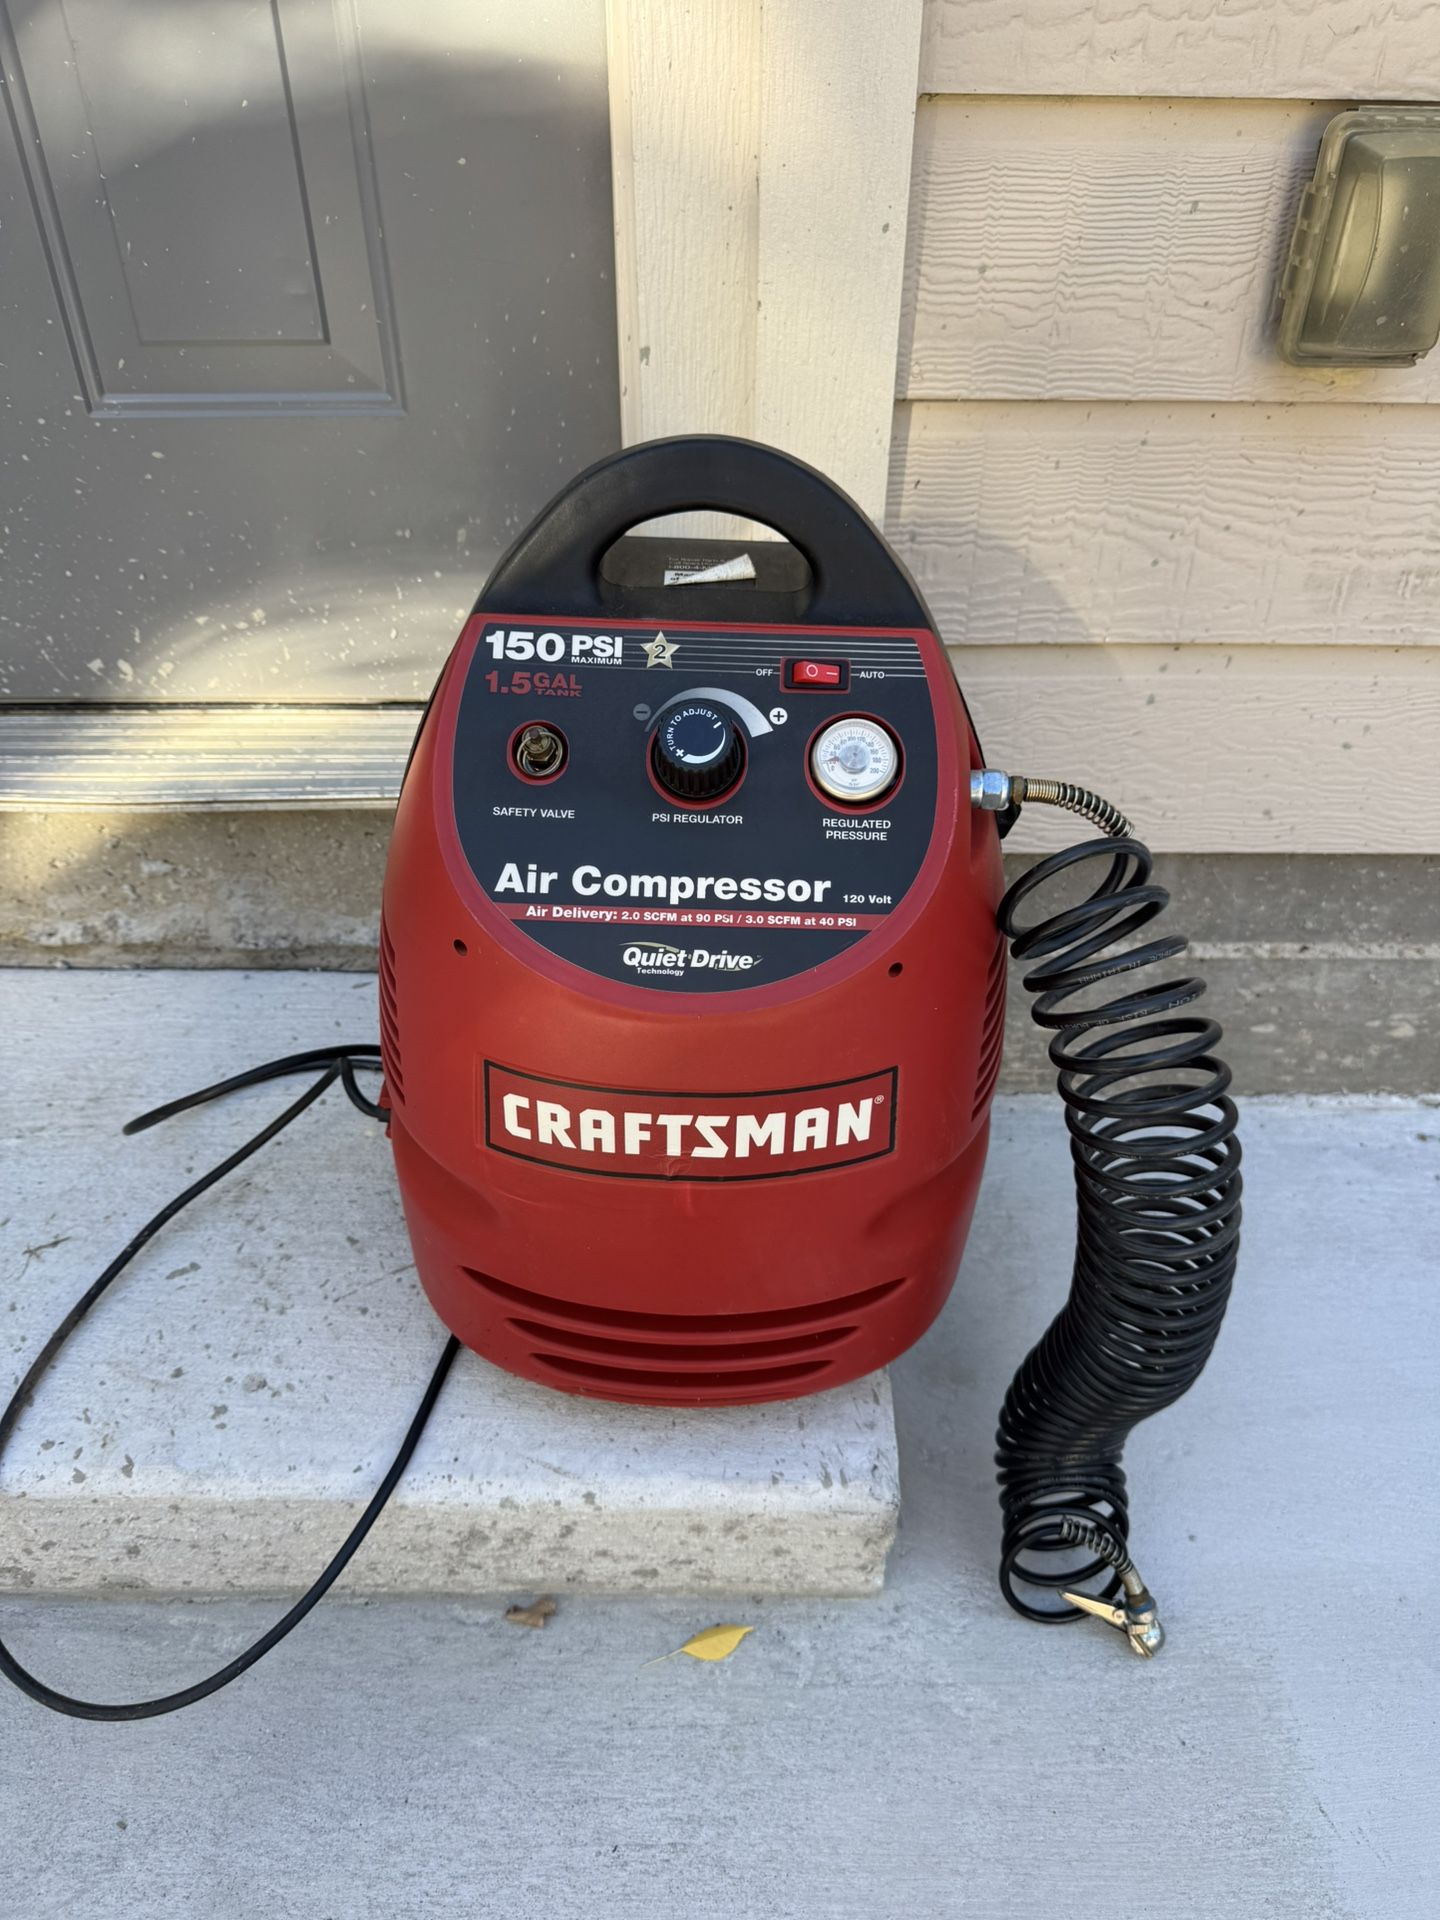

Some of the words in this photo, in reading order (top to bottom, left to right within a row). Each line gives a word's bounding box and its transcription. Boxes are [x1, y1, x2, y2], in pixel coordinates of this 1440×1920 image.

[486, 630, 565, 662] 150
[571, 635, 623, 658] PSI
[653, 644, 667, 659] 2
[571, 657, 622, 665] MAXIMUM
[755, 668, 773, 677] OFF
[859, 671, 885, 679] AUTO
[485, 670, 532, 695] 1.5
[533, 672, 583, 690] GAL
[535, 688, 582, 697] TANK
[666, 727, 675, 751] TURN
[671, 715, 682, 726] TO
[682, 708, 718, 721] ADJUST
[493, 806, 537, 818] SAFETY
[540, 808, 575, 819] VALVE
[652, 813, 670, 823] PSI
[673, 814, 743, 825] REGULATOR
[822, 818, 892, 829] REGULATED
[825, 830, 888, 841] PRESSURE
[494, 862, 558, 894] Air
[572, 865, 832, 905] Compressor
[843, 894, 865, 903] 120
[868, 894, 892, 904] Volt
[526, 905, 548, 917] Air
[552, 906, 618, 922] Delivery:
[621, 911, 640, 920] 2.0
[643, 911, 677, 922] SCFM
[680, 913, 693, 922] at
[696, 913, 711, 923] 90
[714, 914, 733, 924] PSI
[745, 915, 764, 924] 3.0
[767, 916, 800, 925] SCFM
[804, 916, 816, 926] at
[819, 917, 834, 926] 40
[837, 917, 857, 927] PSI
[623, 946, 687, 967] Quiet
[691, 949, 754, 970] Drive
[636, 967, 685, 977] Technology
